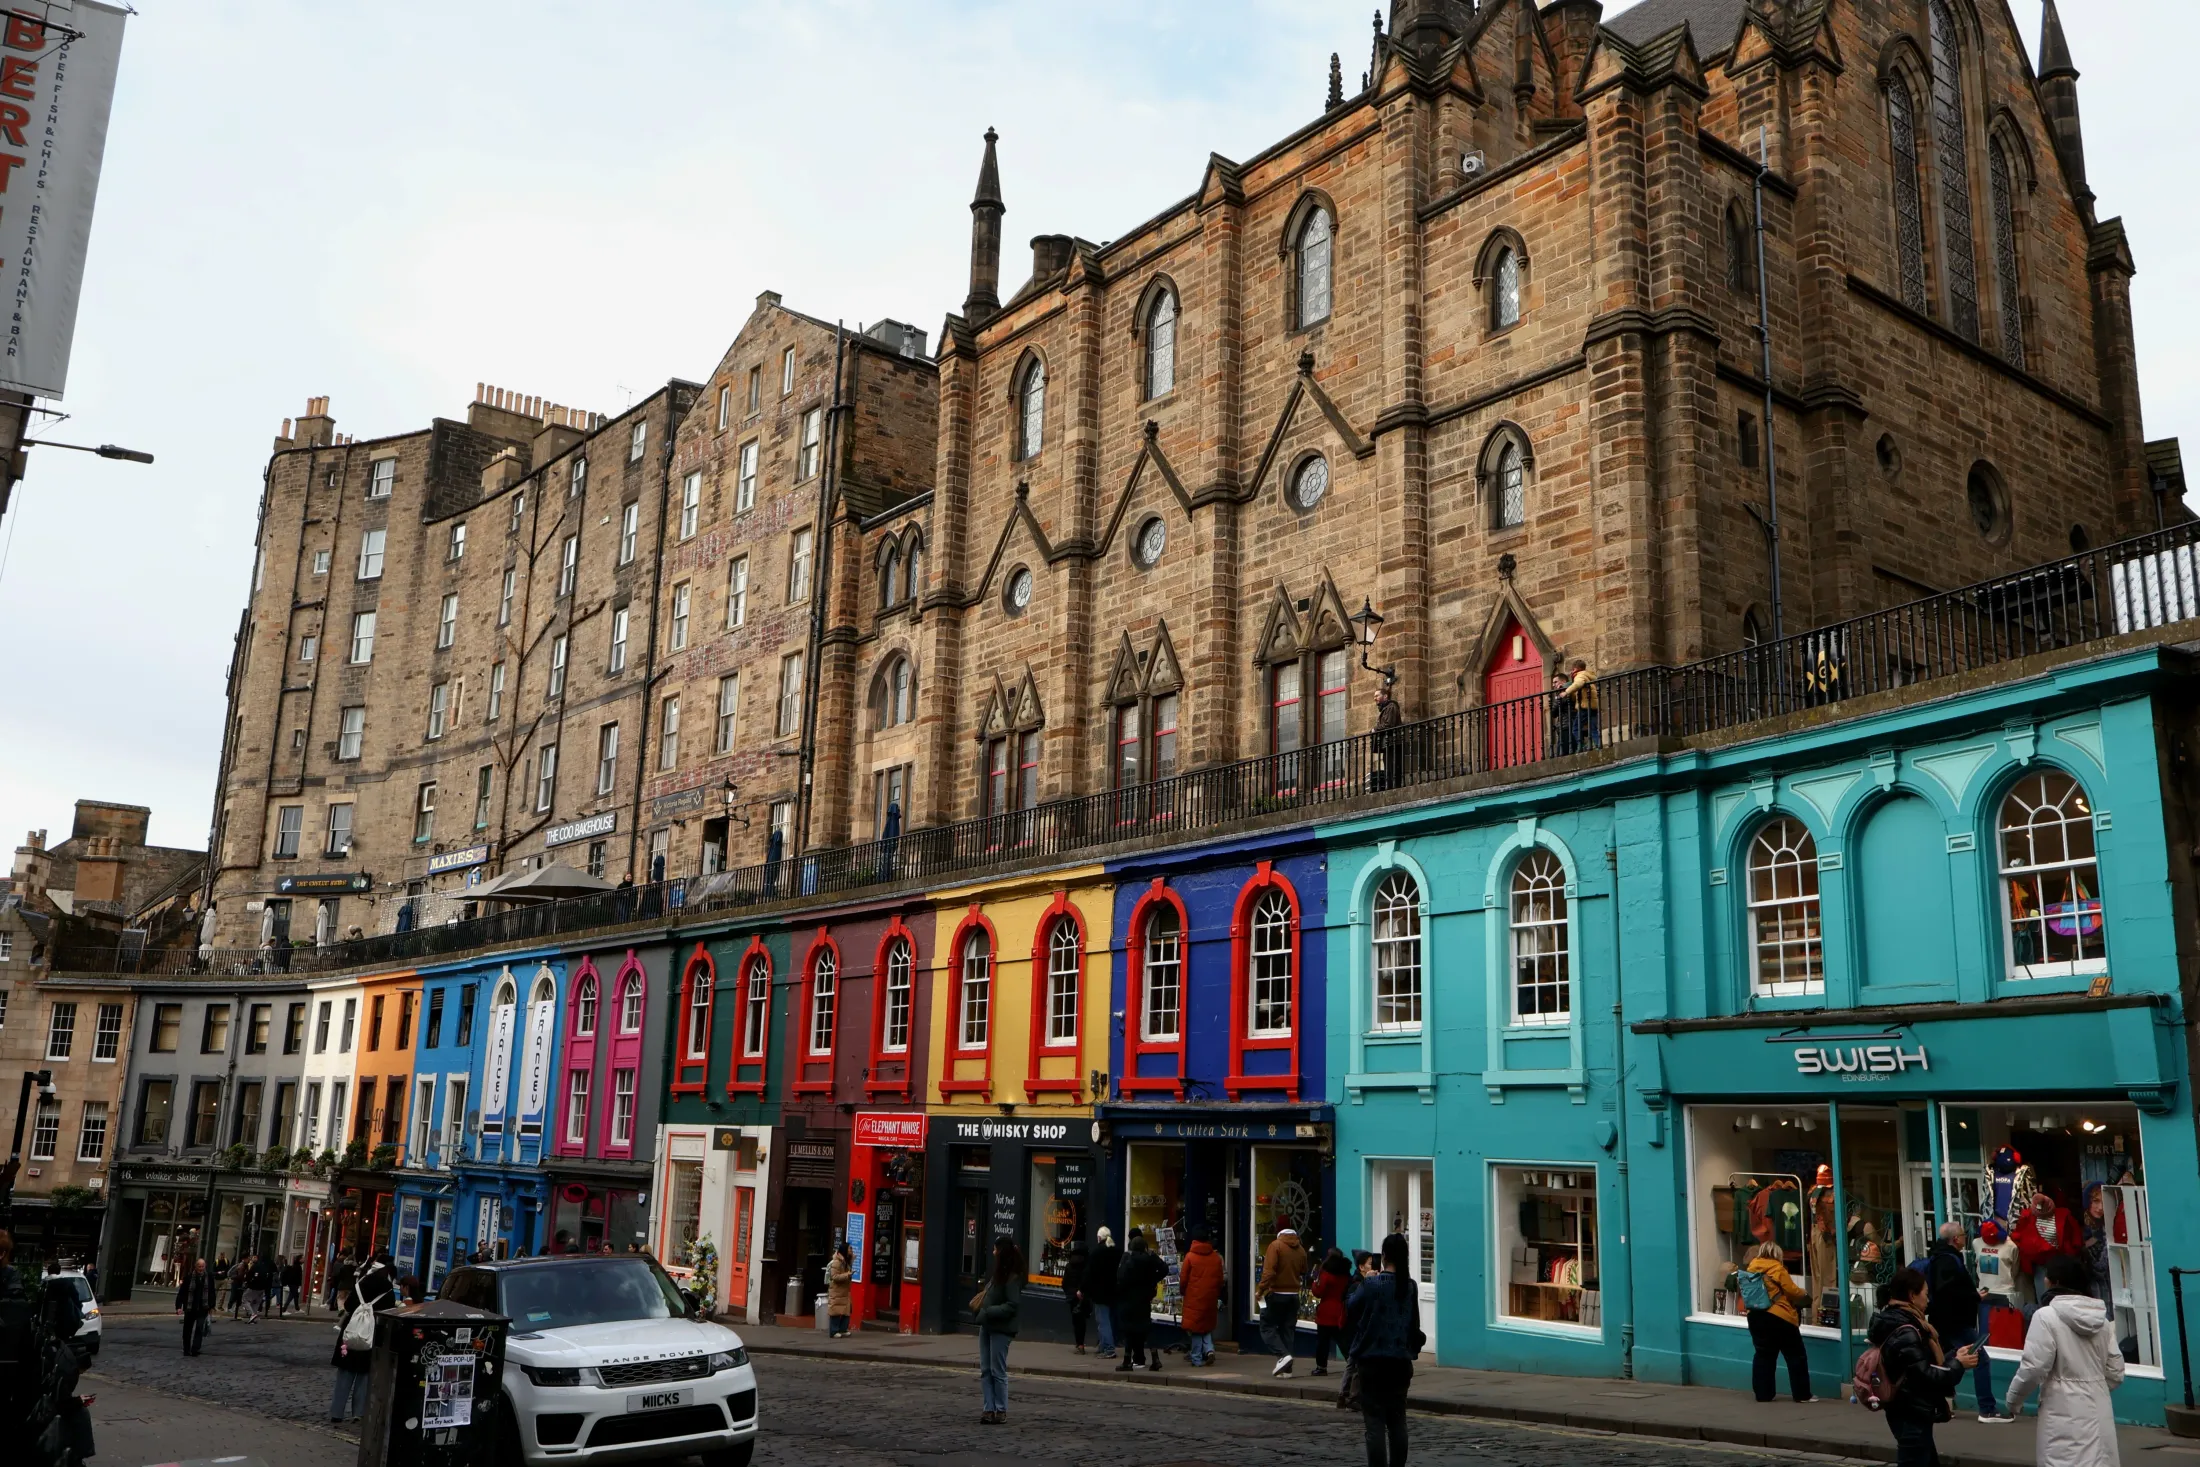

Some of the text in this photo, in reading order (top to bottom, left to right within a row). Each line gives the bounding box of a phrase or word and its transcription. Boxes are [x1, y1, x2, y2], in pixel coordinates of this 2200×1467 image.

[46, 84, 62, 124] FISH
[45, 126, 55, 137] &
[36, 139, 54, 189] CHIPS
[16, 205, 41, 309] RESTAURANT
[12, 312, 22, 322] &
[7, 325, 20, 357] BAR
[546, 814, 614, 844] THE COO BAKEHOUSE
[429, 850, 474, 870] MAXIES
[493, 1009, 509, 1109] FRANCEY
[531, 1005, 547, 1109] FRANCEY
[1794, 1045, 1929, 1073] SWISH
[1841, 1073, 1890, 1082] EDINBURGH
[370, 1107, 385, 1133] 40
[858, 1117, 920, 1135] The ELEPHANT HOUSE
[957, 1123, 1067, 1139] THE WHISKY SHOP
[1220, 1122, 1249, 1138] Sark
[817, 1146, 822, 1155] &
[821, 1146, 835, 1156] SON
[145, 1171, 173, 1181] Walker
[176, 1172, 200, 1182] Slater
[1058, 1176, 1087, 1184] WHISKY
[994, 1192, 1005, 1205] Not
[993, 1209, 1016, 1220] Another
[993, 1222, 1014, 1238] Whisky
[602, 1349, 704, 1364] RANGE ROVER
